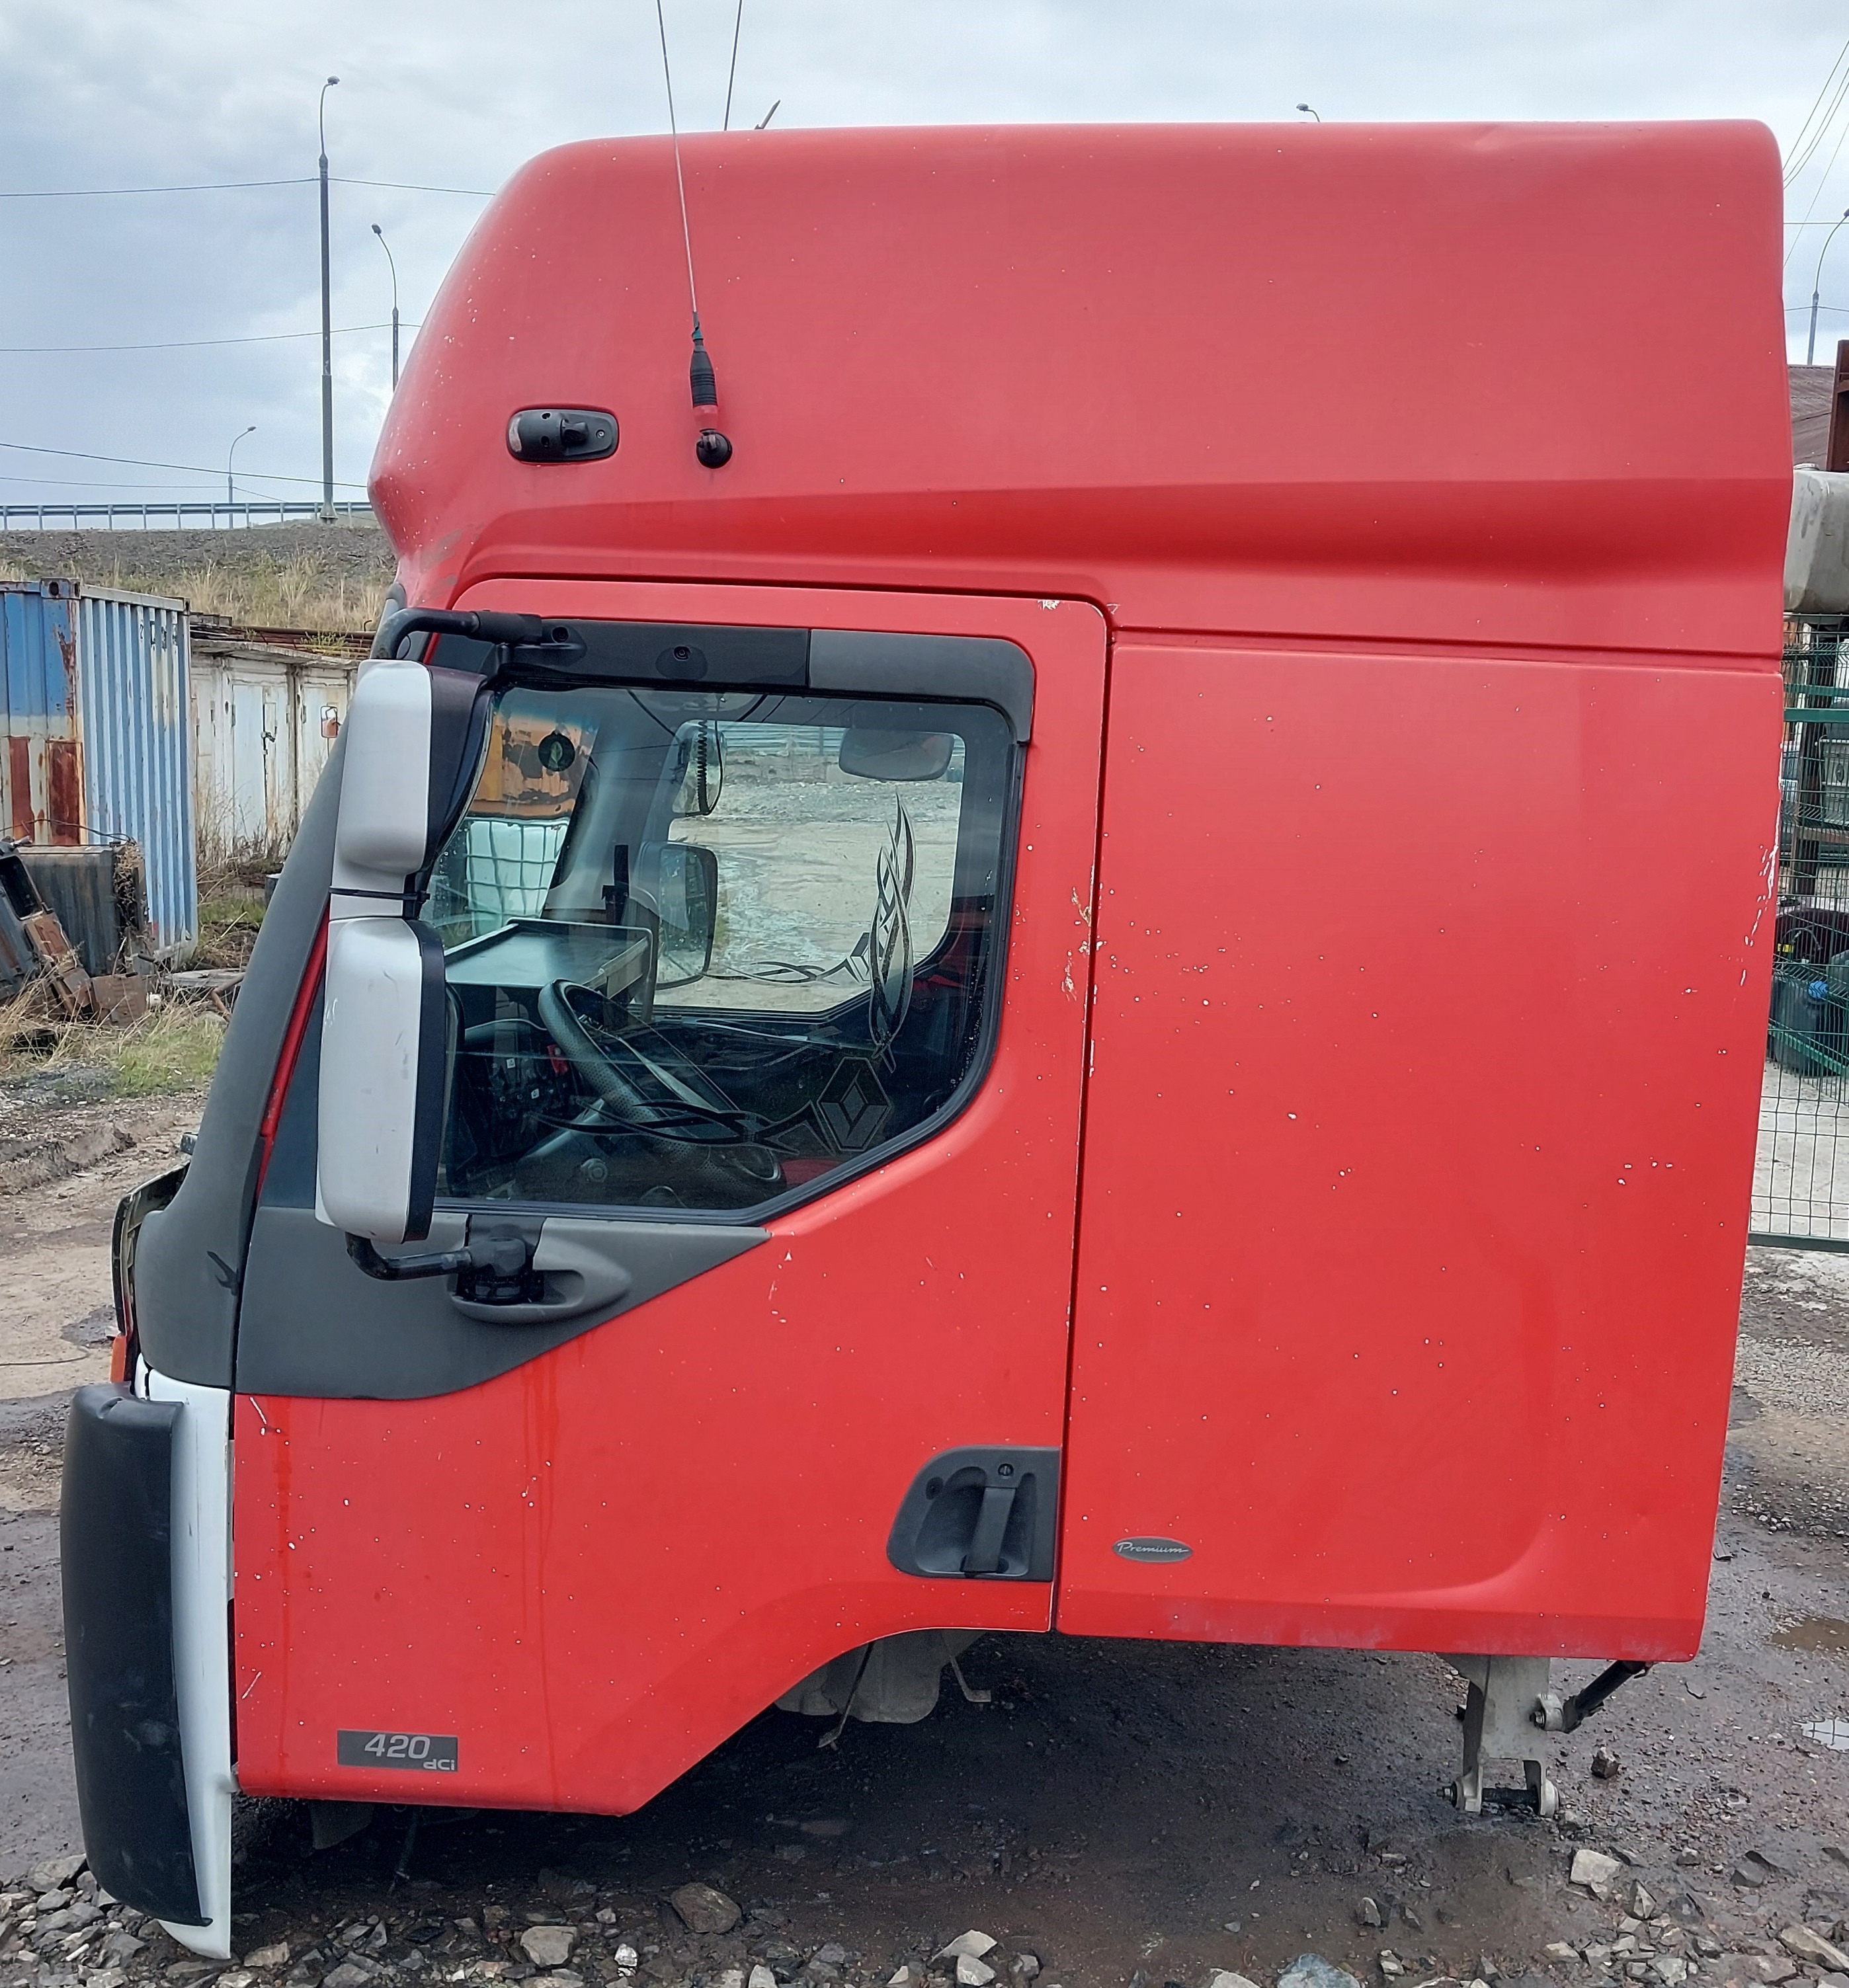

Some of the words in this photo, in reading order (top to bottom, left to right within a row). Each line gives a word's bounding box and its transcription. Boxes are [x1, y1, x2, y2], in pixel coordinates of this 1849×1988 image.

[1117, 1541, 1189, 1553] Premium
[364, 1733, 431, 1759] 420
[423, 1759, 455, 1770] dCi
